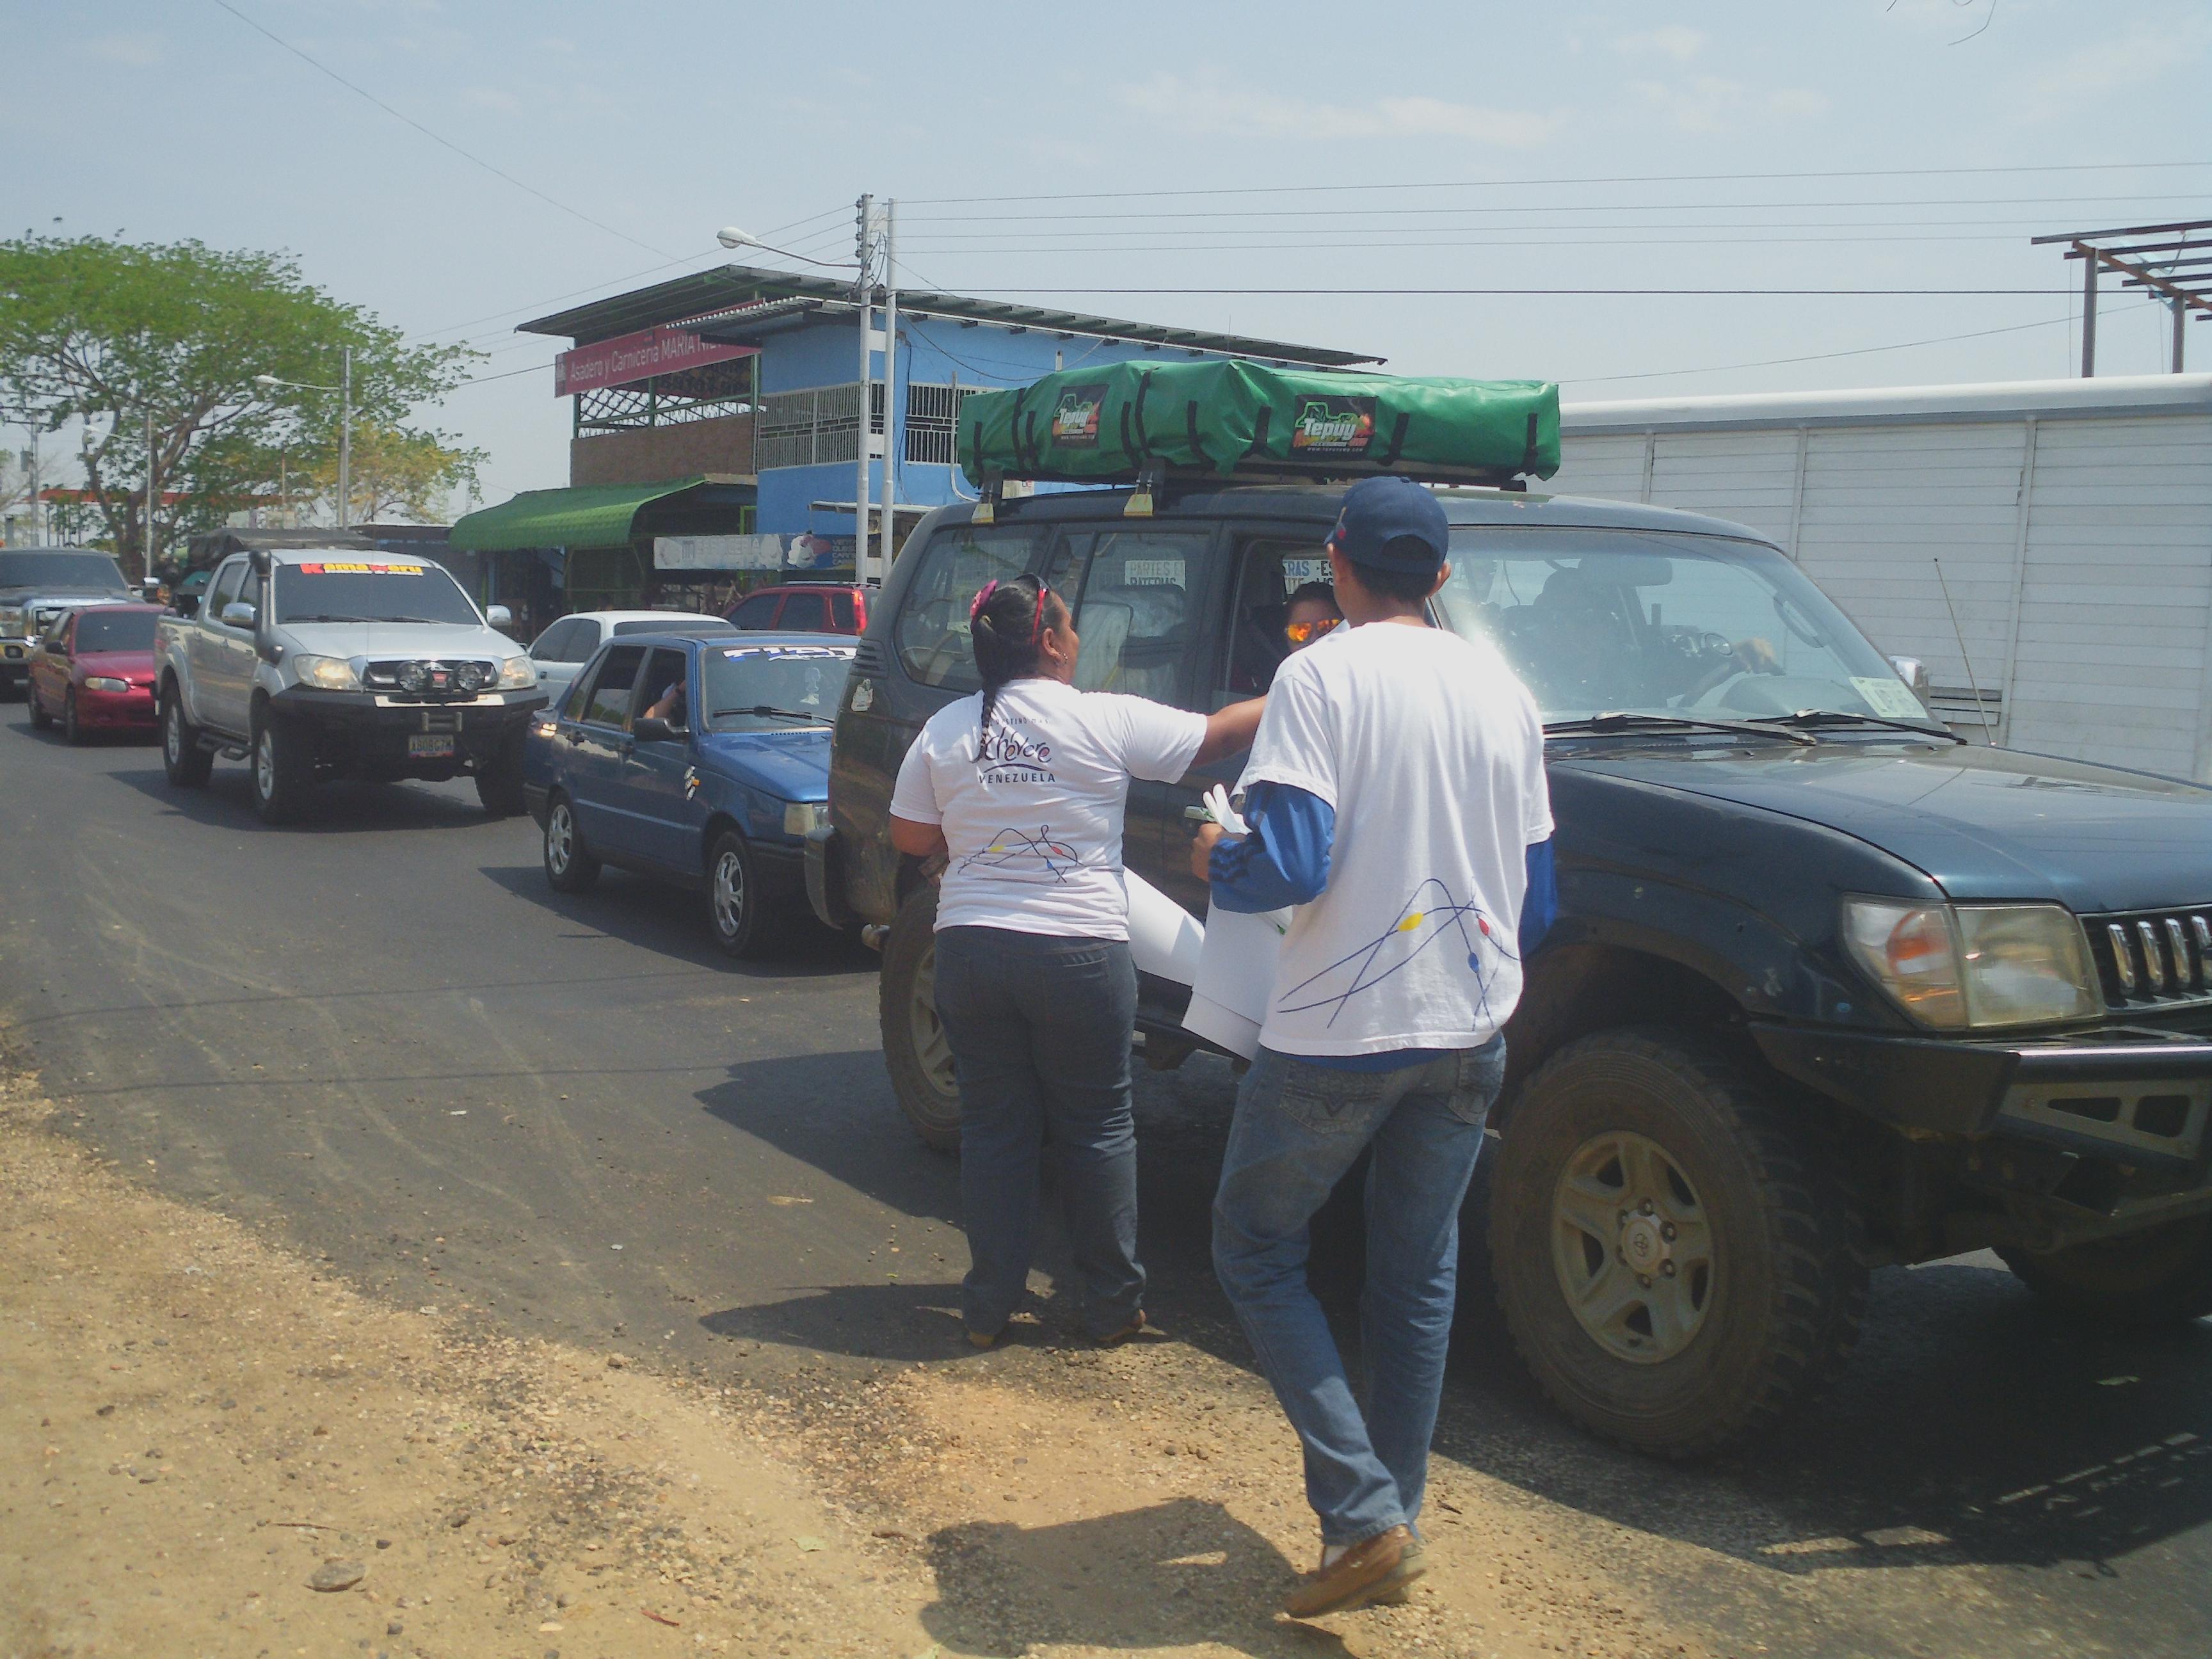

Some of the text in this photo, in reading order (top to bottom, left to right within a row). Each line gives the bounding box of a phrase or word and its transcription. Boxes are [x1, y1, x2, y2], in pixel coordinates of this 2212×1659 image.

[570, 362, 602, 381] Asadero
[604, 362, 610, 380] y
[1059, 408, 1090, 428] Tepuy
[1304, 417, 1356, 441] Tepuy
[1130, 562, 1171, 576] PARTES
[979, 773, 1055, 784] VENEZUELA
